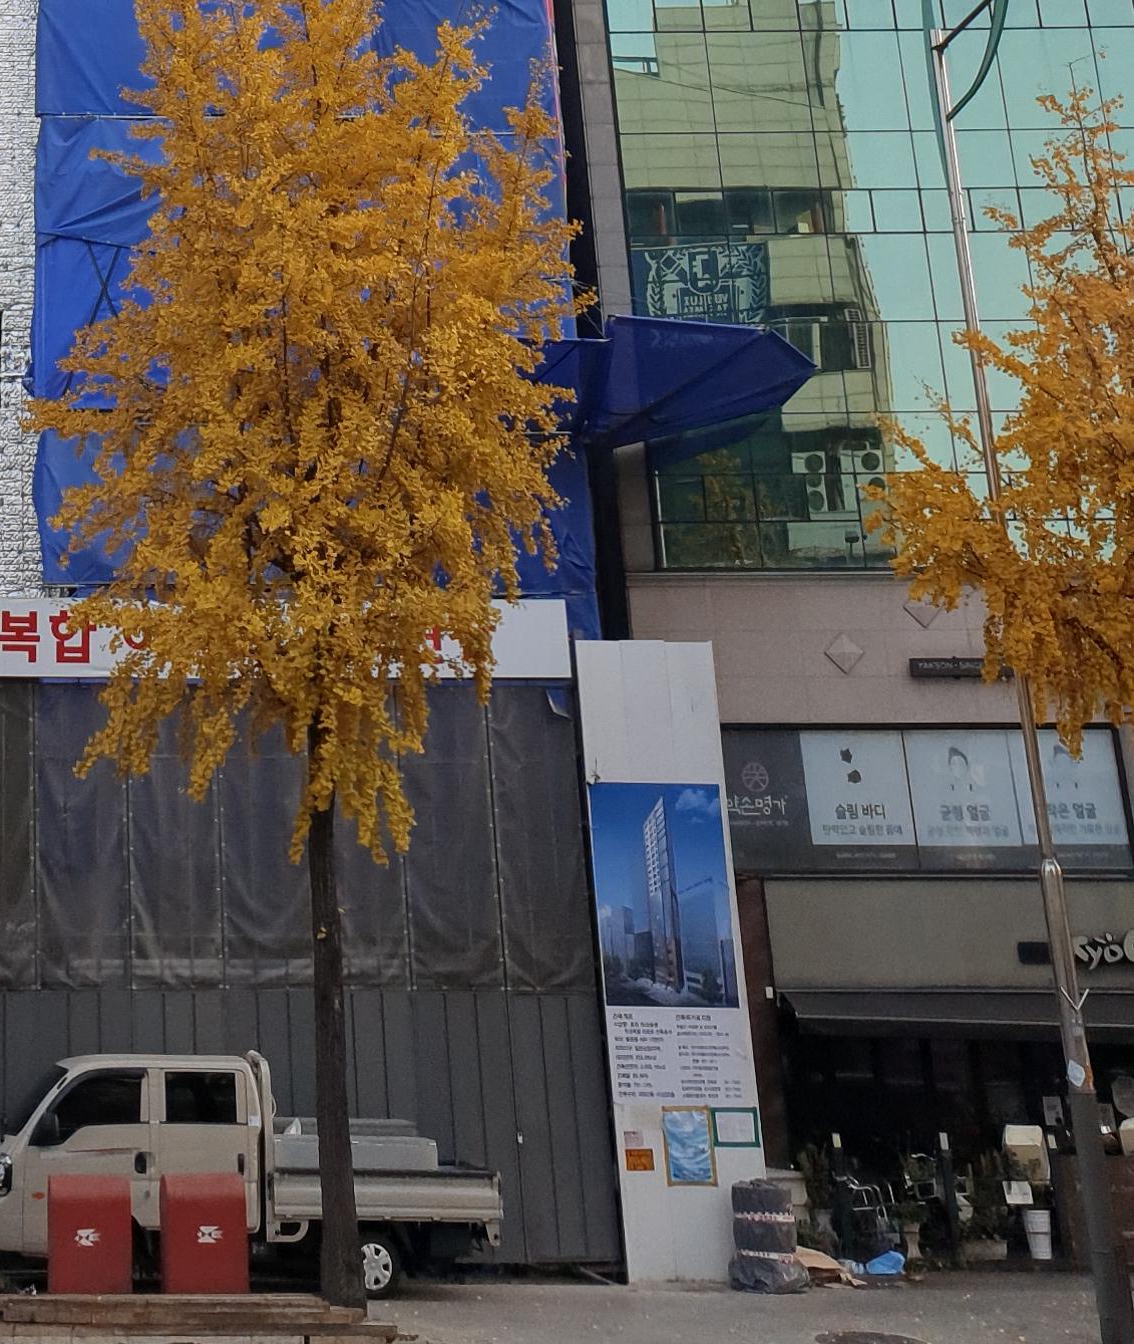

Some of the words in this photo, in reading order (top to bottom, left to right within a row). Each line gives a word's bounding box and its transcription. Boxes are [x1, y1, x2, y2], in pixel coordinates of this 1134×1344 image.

[835, 803, 859, 820] 슬림
[861, 803, 886, 820] 바디
[967, 803, 990, 822] 얼굴
[1072, 802, 1097, 820] 얼굴
